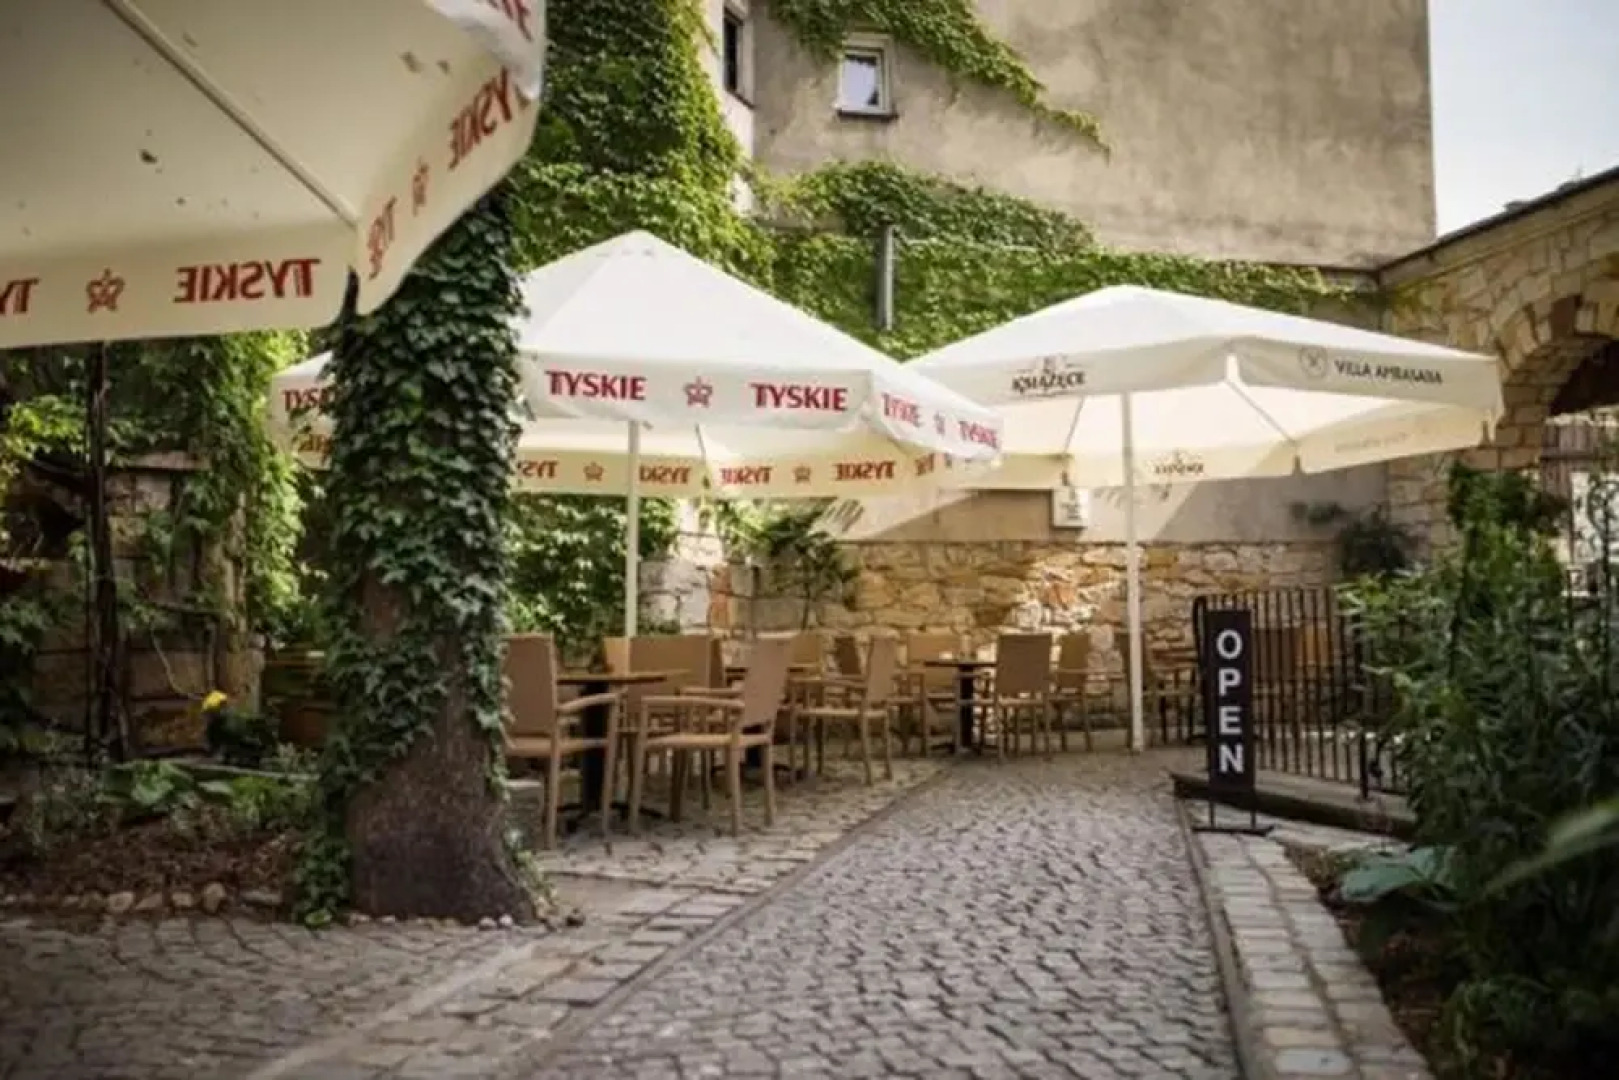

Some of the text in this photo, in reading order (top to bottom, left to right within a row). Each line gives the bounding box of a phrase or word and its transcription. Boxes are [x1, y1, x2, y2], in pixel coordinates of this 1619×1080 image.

[545, 370, 848, 411] TYSKIE TYSKIE
[1216, 629, 1244, 773] OPEN
